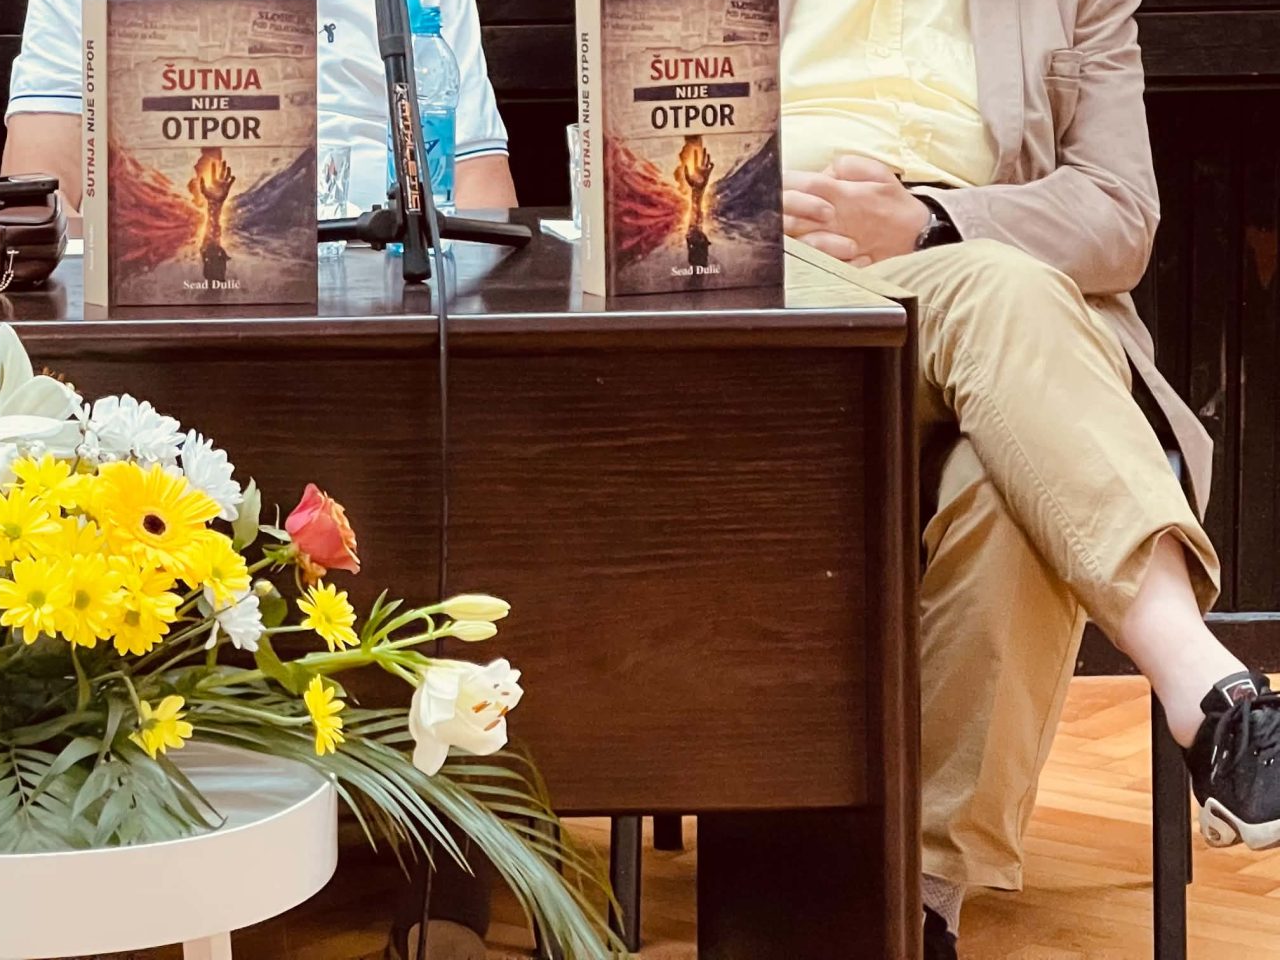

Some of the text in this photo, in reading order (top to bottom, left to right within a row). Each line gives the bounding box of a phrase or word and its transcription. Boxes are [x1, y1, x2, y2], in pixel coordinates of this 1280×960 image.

[86, 40, 95, 93] OTPOR
[581, 32, 590, 85] OTPOR
[650, 54, 735, 81] ŠUTNJA
[161, 64, 262, 91] ŠUTNJA
[191, 96, 230, 110] NIJE
[675, 86, 709, 99] NIJE
[87, 99, 95, 133] NIJE
[581, 90, 590, 124] NIJE
[651, 103, 736, 130] OTPOR
[161, 116, 262, 141] OTPOR
